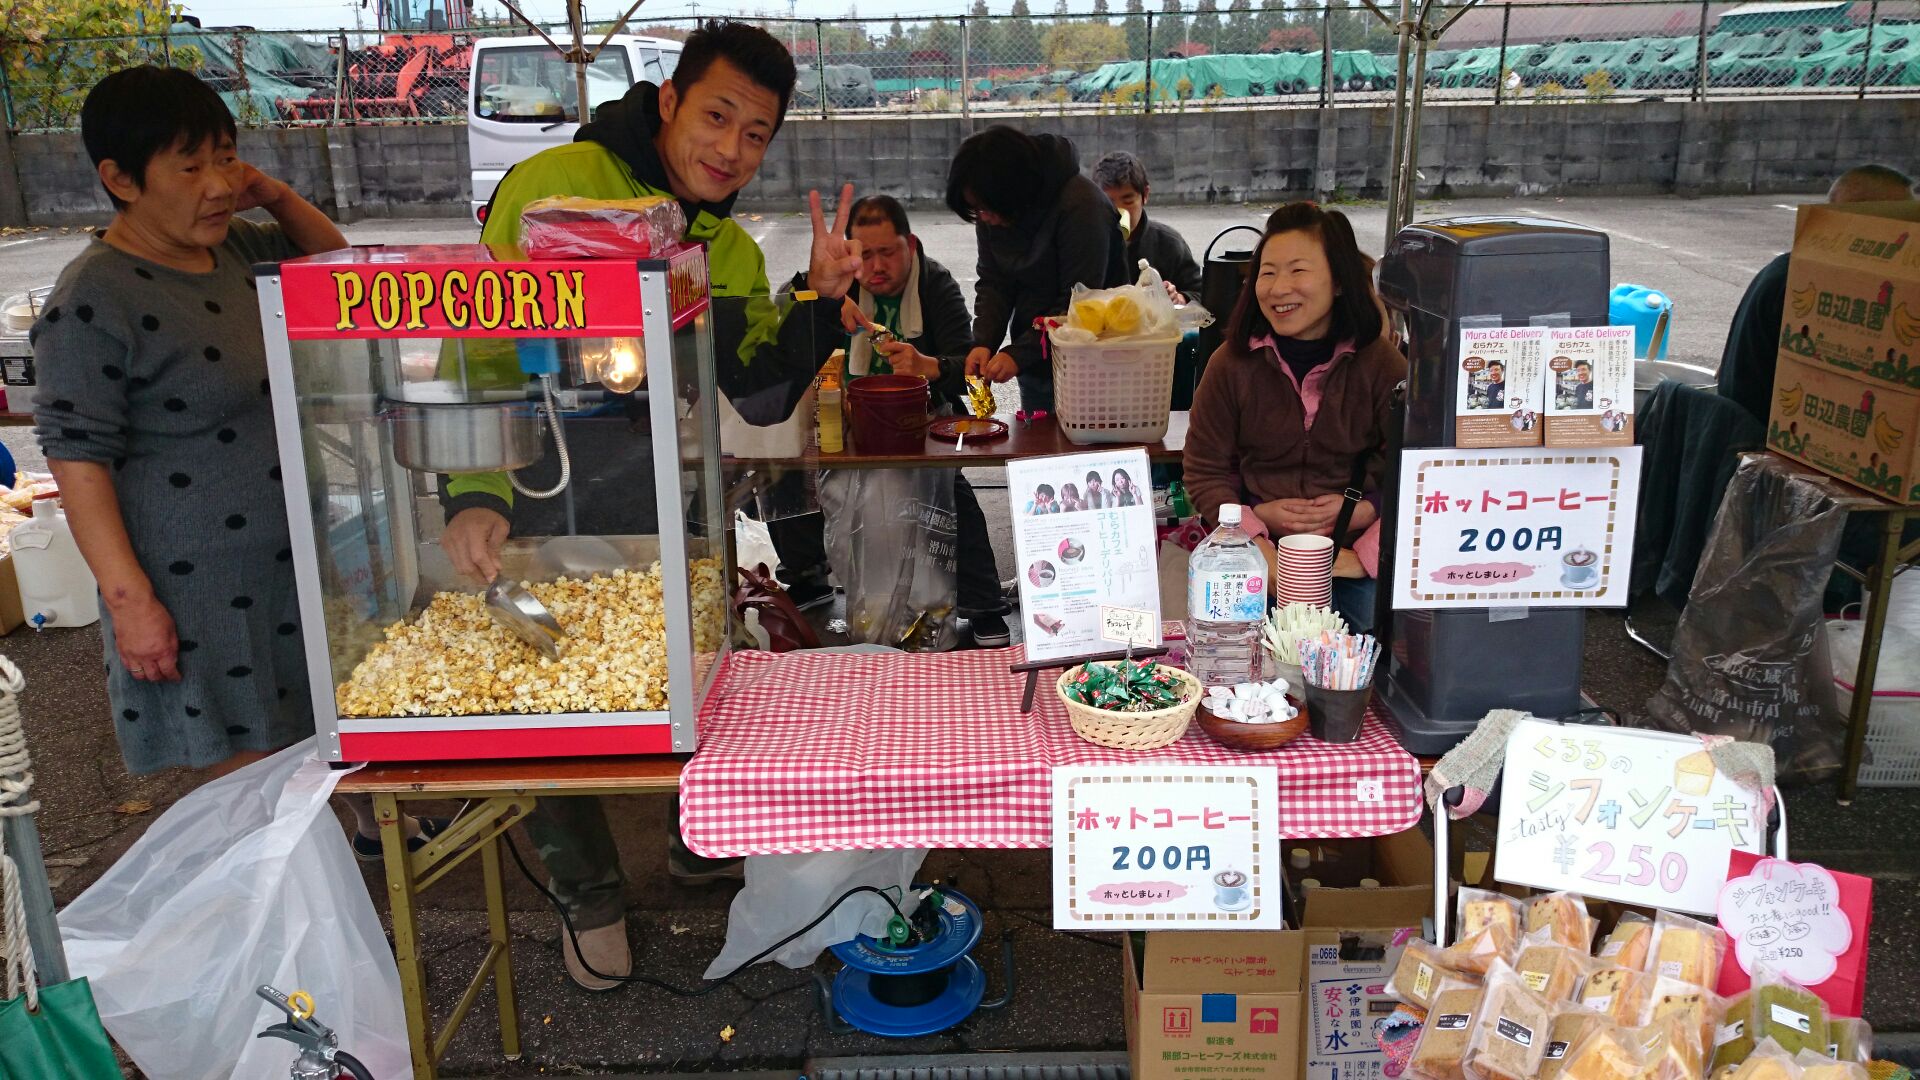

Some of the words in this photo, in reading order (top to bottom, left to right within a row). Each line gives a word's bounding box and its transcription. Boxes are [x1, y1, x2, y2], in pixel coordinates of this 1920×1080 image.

[332, 270, 586, 330] POPCORN
[1816, 291, 1885, 333] 田辺農園
[1465, 331, 1487, 340] Mura
[1490, 330, 1508, 339] Café
[1510, 329, 1544, 339] Delivery
[1472, 341, 1505, 349] むらカフェ
[1551, 331, 1573, 340] Mura
[1575, 330, 1594, 339] Café
[1596, 328, 1632, 338] Delivery
[1558, 341, 1591, 349] むらカフェ
[1804, 393, 1869, 439] 田辺農園
[1424, 488, 1609, 514] ホットコーヒー
[1108, 511, 1123, 555] むらカフェ
[1458, 525, 1563, 553] 200円
[1097, 512, 1113, 597] コーヒーデリバリー
[1446, 569, 1518, 581] ホッとしましょ！
[1209, 582, 1223, 619] 日本の水
[1533, 736, 1633, 774] くるるの
[1076, 807, 1251, 831] ホットコーヒー
[1526, 769, 1749, 847] シフォンケーキ
[1112, 845, 1211, 871] 200円
[1553, 834, 1688, 894] ¥250
[1104, 889, 1171, 900] ホッとしましょ！
[1732, 877, 1827, 909] シフォンケーキ
[1319, 947, 1337, 959] 0668
[1323, 986, 1349, 1051] 安心な水
[1348, 997, 1362, 1038] 伊藤園の
[1206, 1036, 1235, 1046] 製造者
